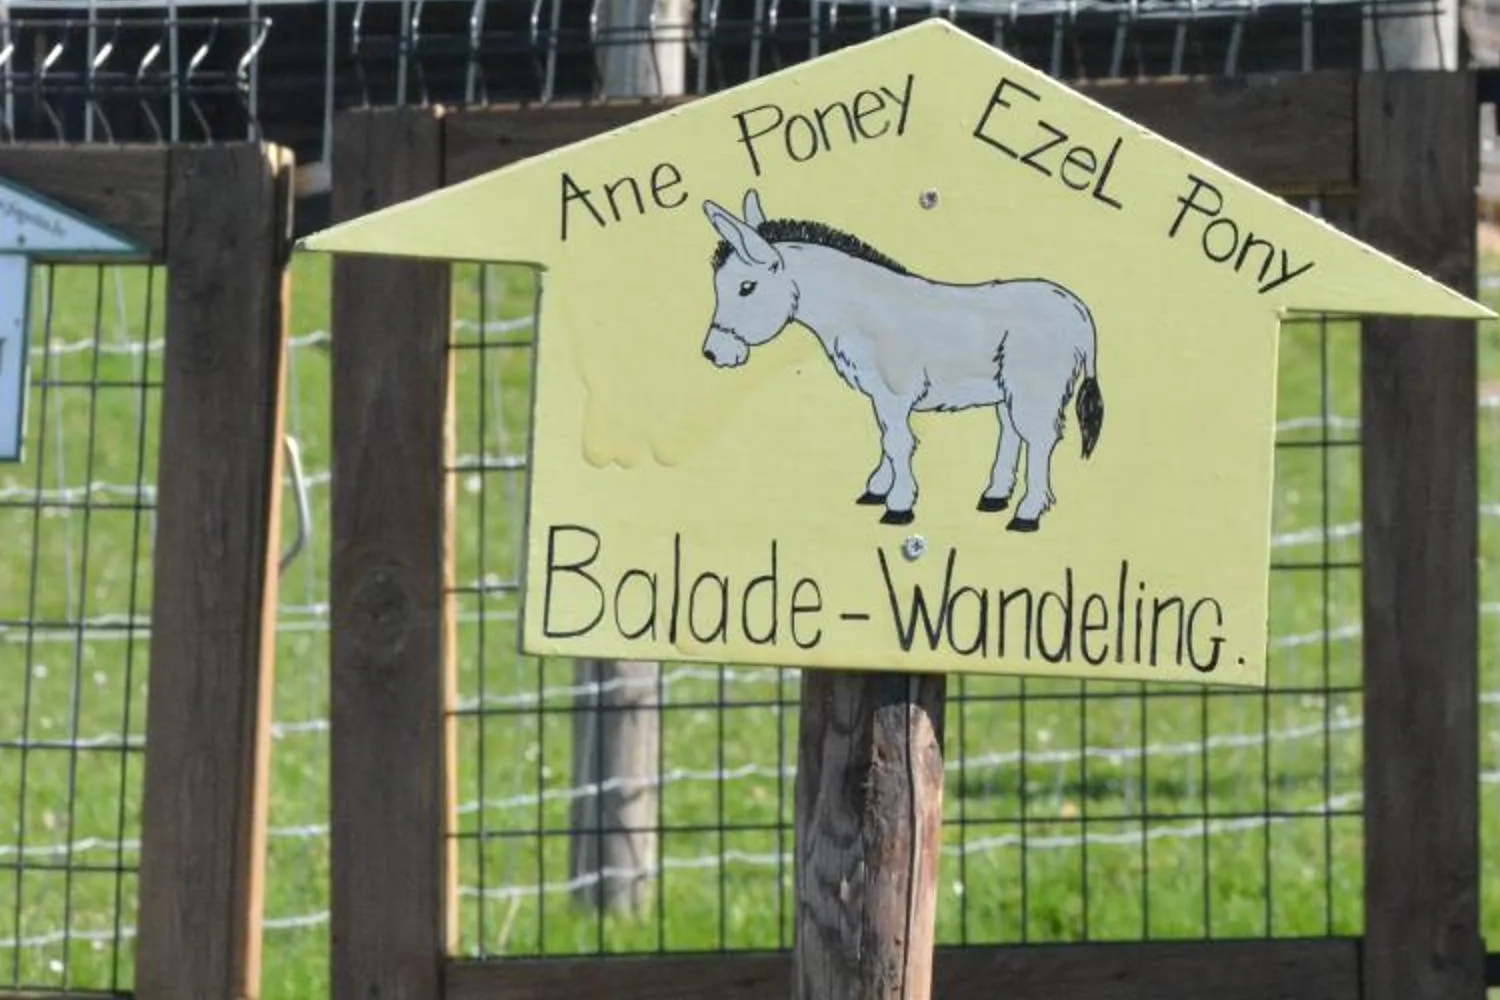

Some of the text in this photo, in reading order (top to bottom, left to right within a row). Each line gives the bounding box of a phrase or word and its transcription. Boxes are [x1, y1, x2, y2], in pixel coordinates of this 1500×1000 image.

[560, 162, 689, 242] Ane
[731, 73, 915, 177] Poney
[1168, 173, 1315, 294] Pony
